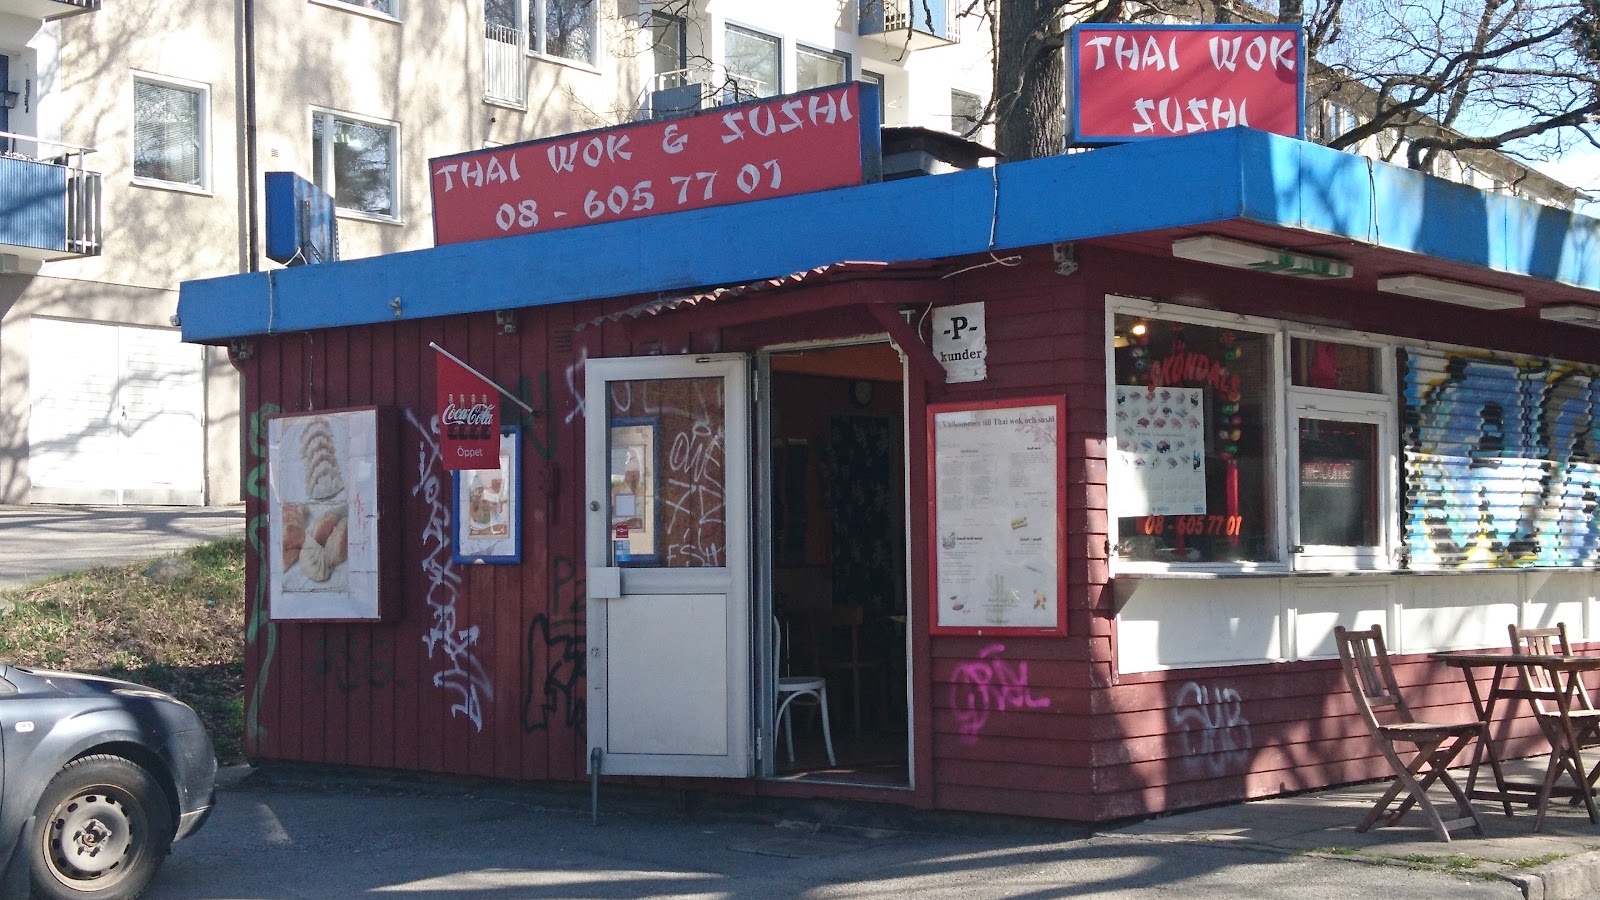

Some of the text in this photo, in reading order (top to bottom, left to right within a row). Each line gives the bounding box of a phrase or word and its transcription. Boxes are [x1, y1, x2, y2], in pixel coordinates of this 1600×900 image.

[1085, 35, 1296, 72] THAI WOK
[1132, 97, 1249, 133] SUSHI
[435, 90, 853, 192] THAI WOK & SUSHI
[496, 159, 782, 231] 08 - 605 77 01
[940, 349, 983, 363] kunder
[442, 403, 496, 426] Coca-Cola
[994, 417, 1009, 427] Thai
[457, 446, 483, 458] Öppet
[1144, 514, 1164, 535] 08
[1207, 515, 1224, 535] 77
[1226, 515, 1242, 536] 01
